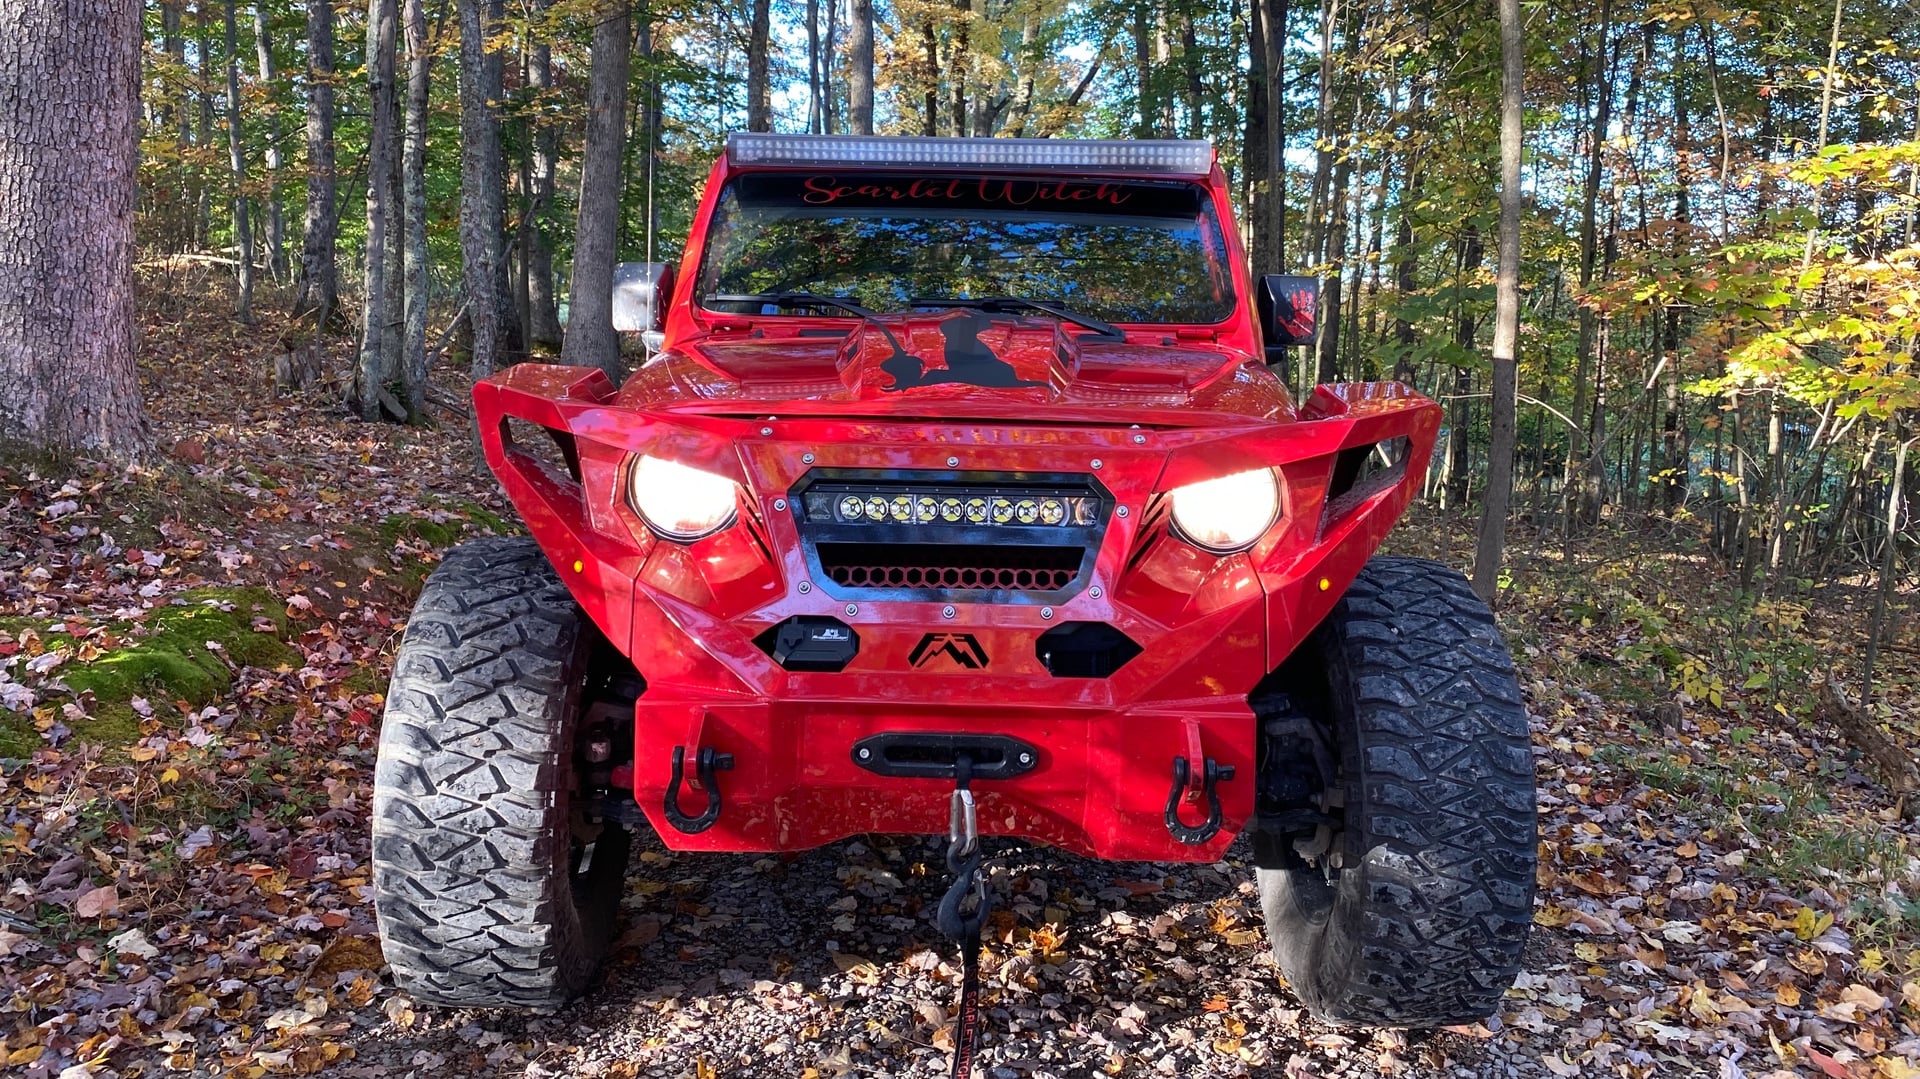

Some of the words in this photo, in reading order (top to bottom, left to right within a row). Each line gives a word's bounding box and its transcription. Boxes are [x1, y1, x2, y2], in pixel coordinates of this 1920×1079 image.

[804, 174, 962, 204] Scarlet
[978, 175, 1131, 205] Witch
[963, 991, 977, 1043] SCARLET
